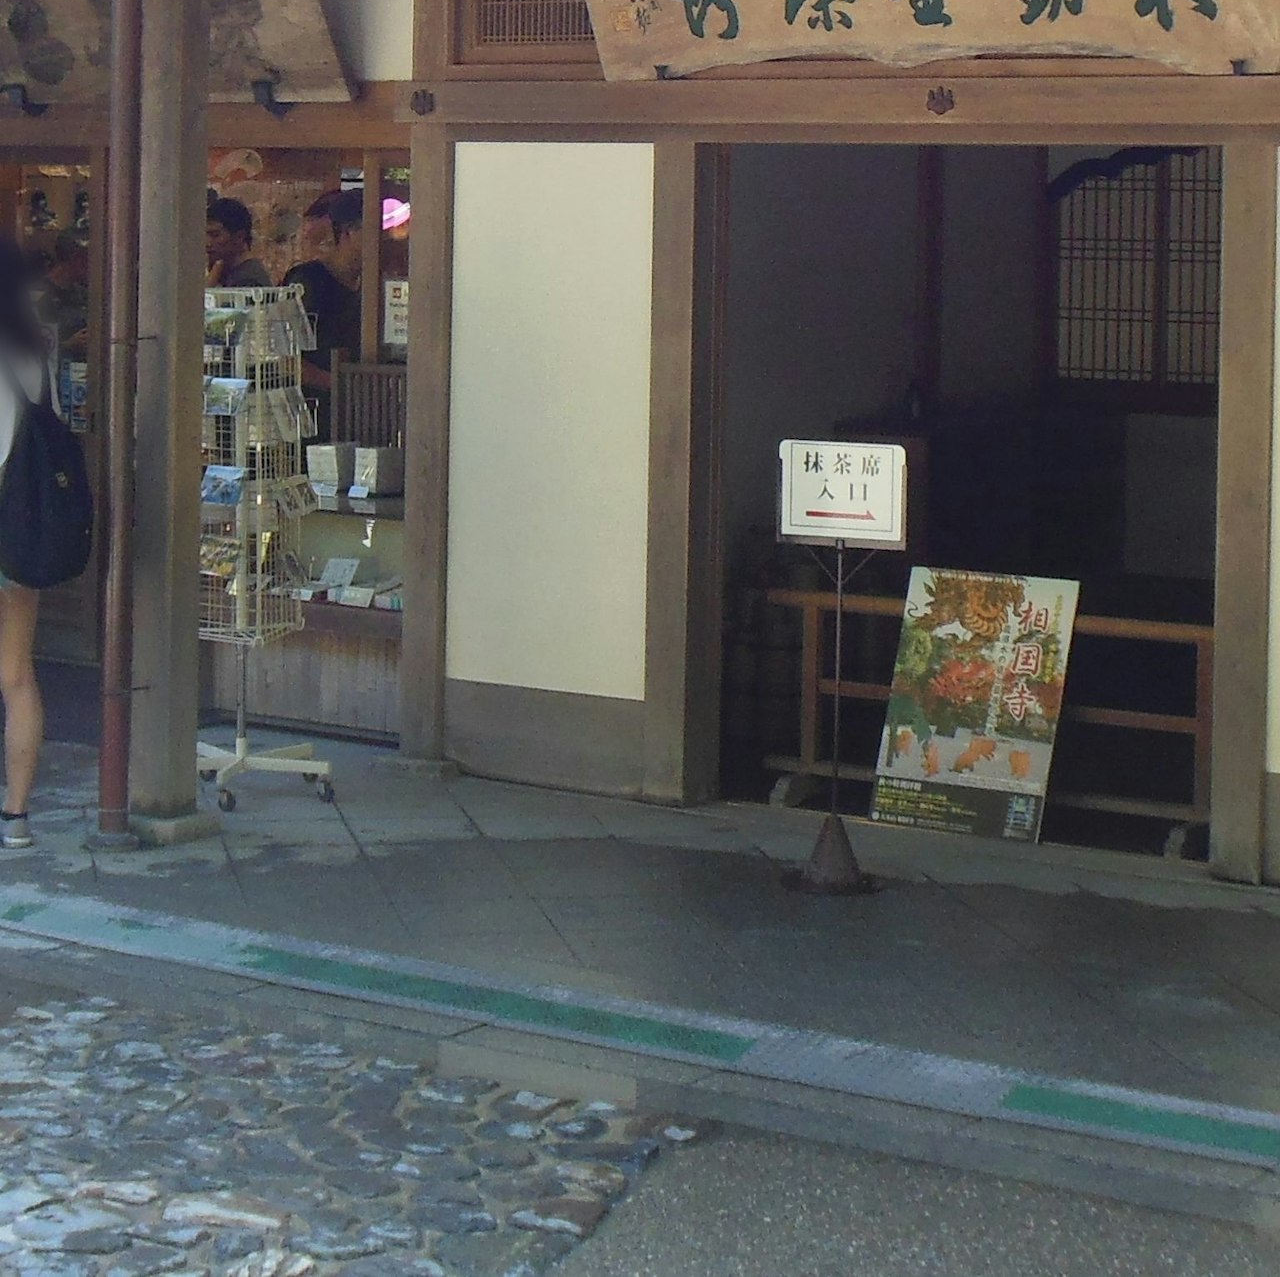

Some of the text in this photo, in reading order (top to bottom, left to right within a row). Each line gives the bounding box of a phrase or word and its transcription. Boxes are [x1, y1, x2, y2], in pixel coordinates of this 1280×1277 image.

[803, 450, 881, 477] 抹茶席
[817, 478, 868, 502] 入口
[1004, 601, 1050, 721] 相国寺
